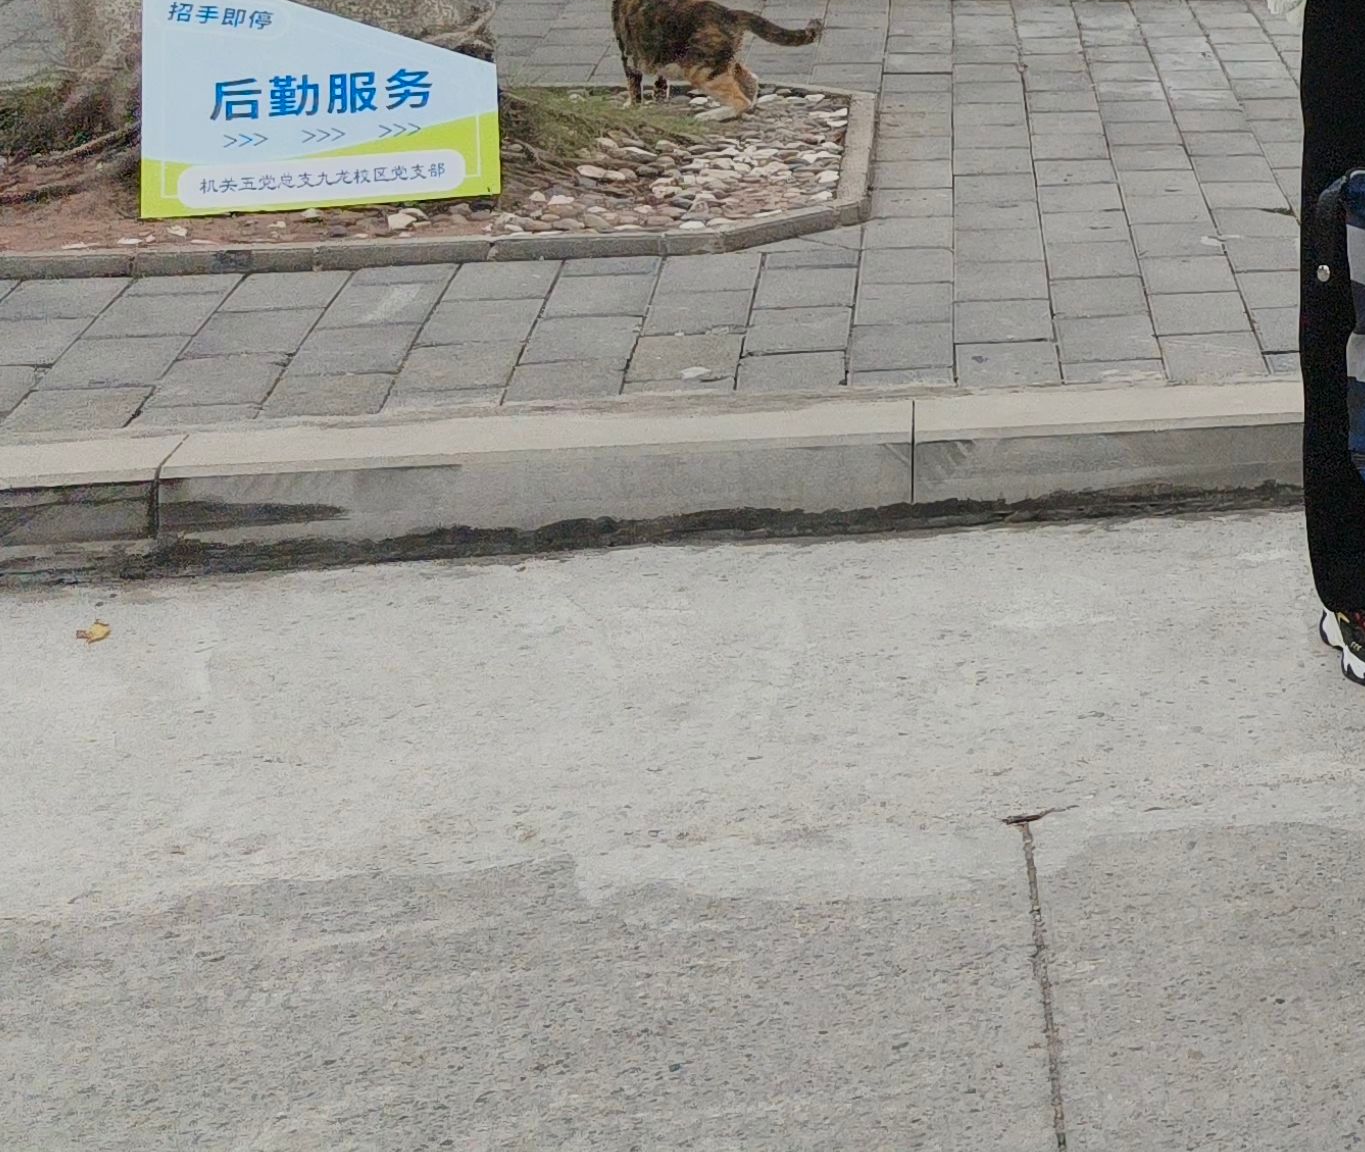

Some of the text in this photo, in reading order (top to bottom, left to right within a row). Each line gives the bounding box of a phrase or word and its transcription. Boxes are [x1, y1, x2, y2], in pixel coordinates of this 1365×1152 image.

[166, 1, 275, 31] 招手即停
[209, 67, 433, 122] 后勤服务
